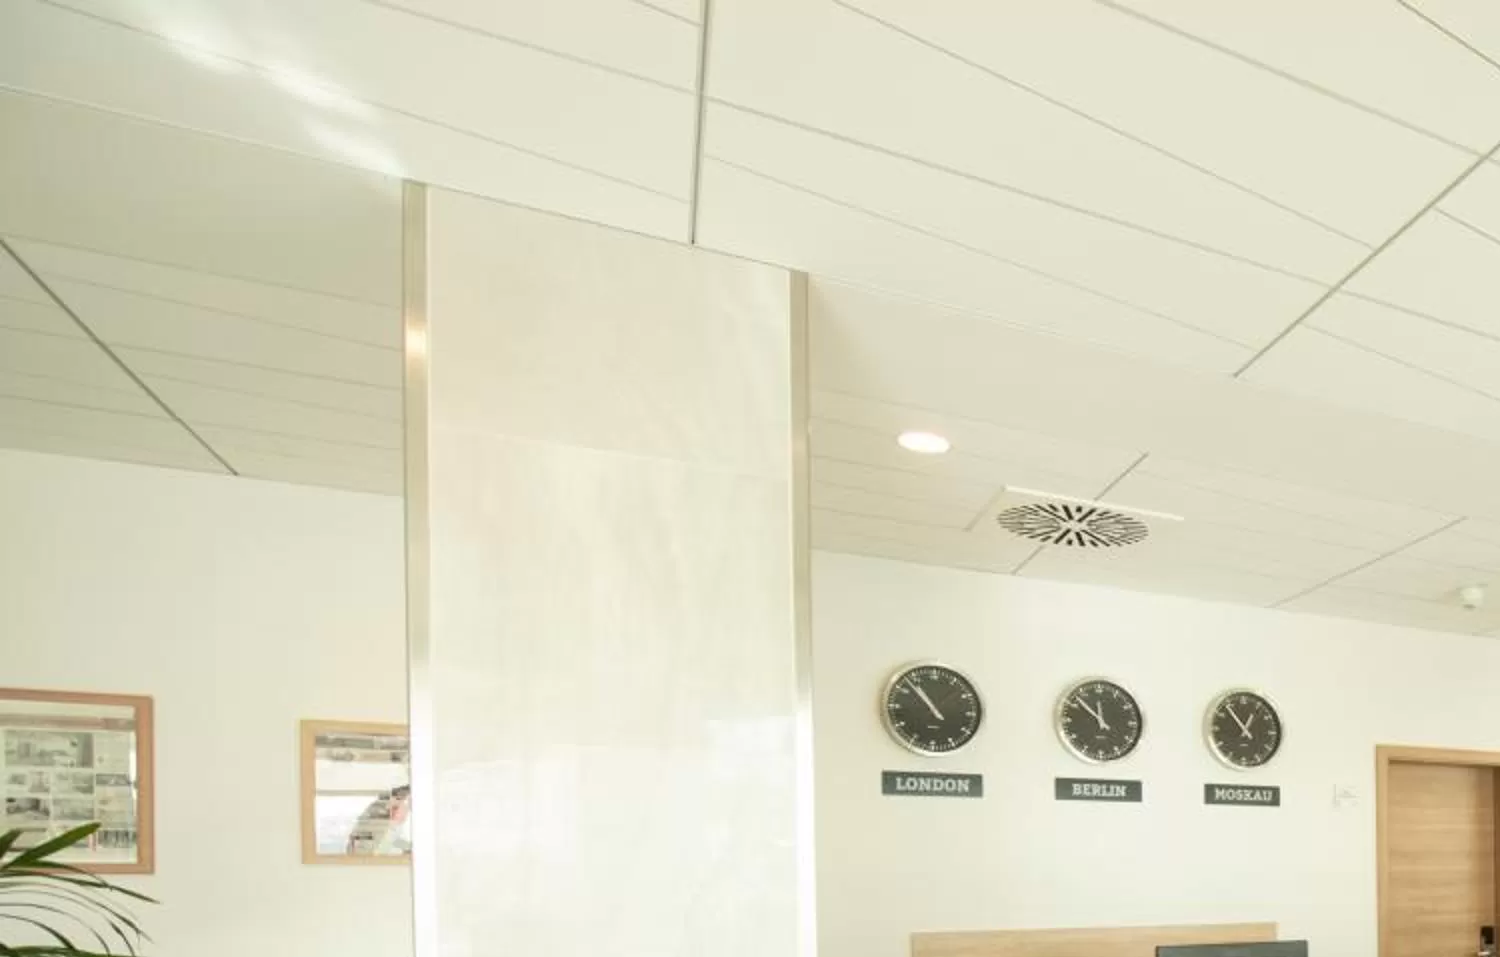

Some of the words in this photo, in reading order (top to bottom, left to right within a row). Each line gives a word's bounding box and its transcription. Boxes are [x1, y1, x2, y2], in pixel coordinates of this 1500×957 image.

[895, 776, 970, 793] LONDON
[1071, 782, 1128, 798] BERLIN
[1214, 787, 1273, 802] MOSKAU
